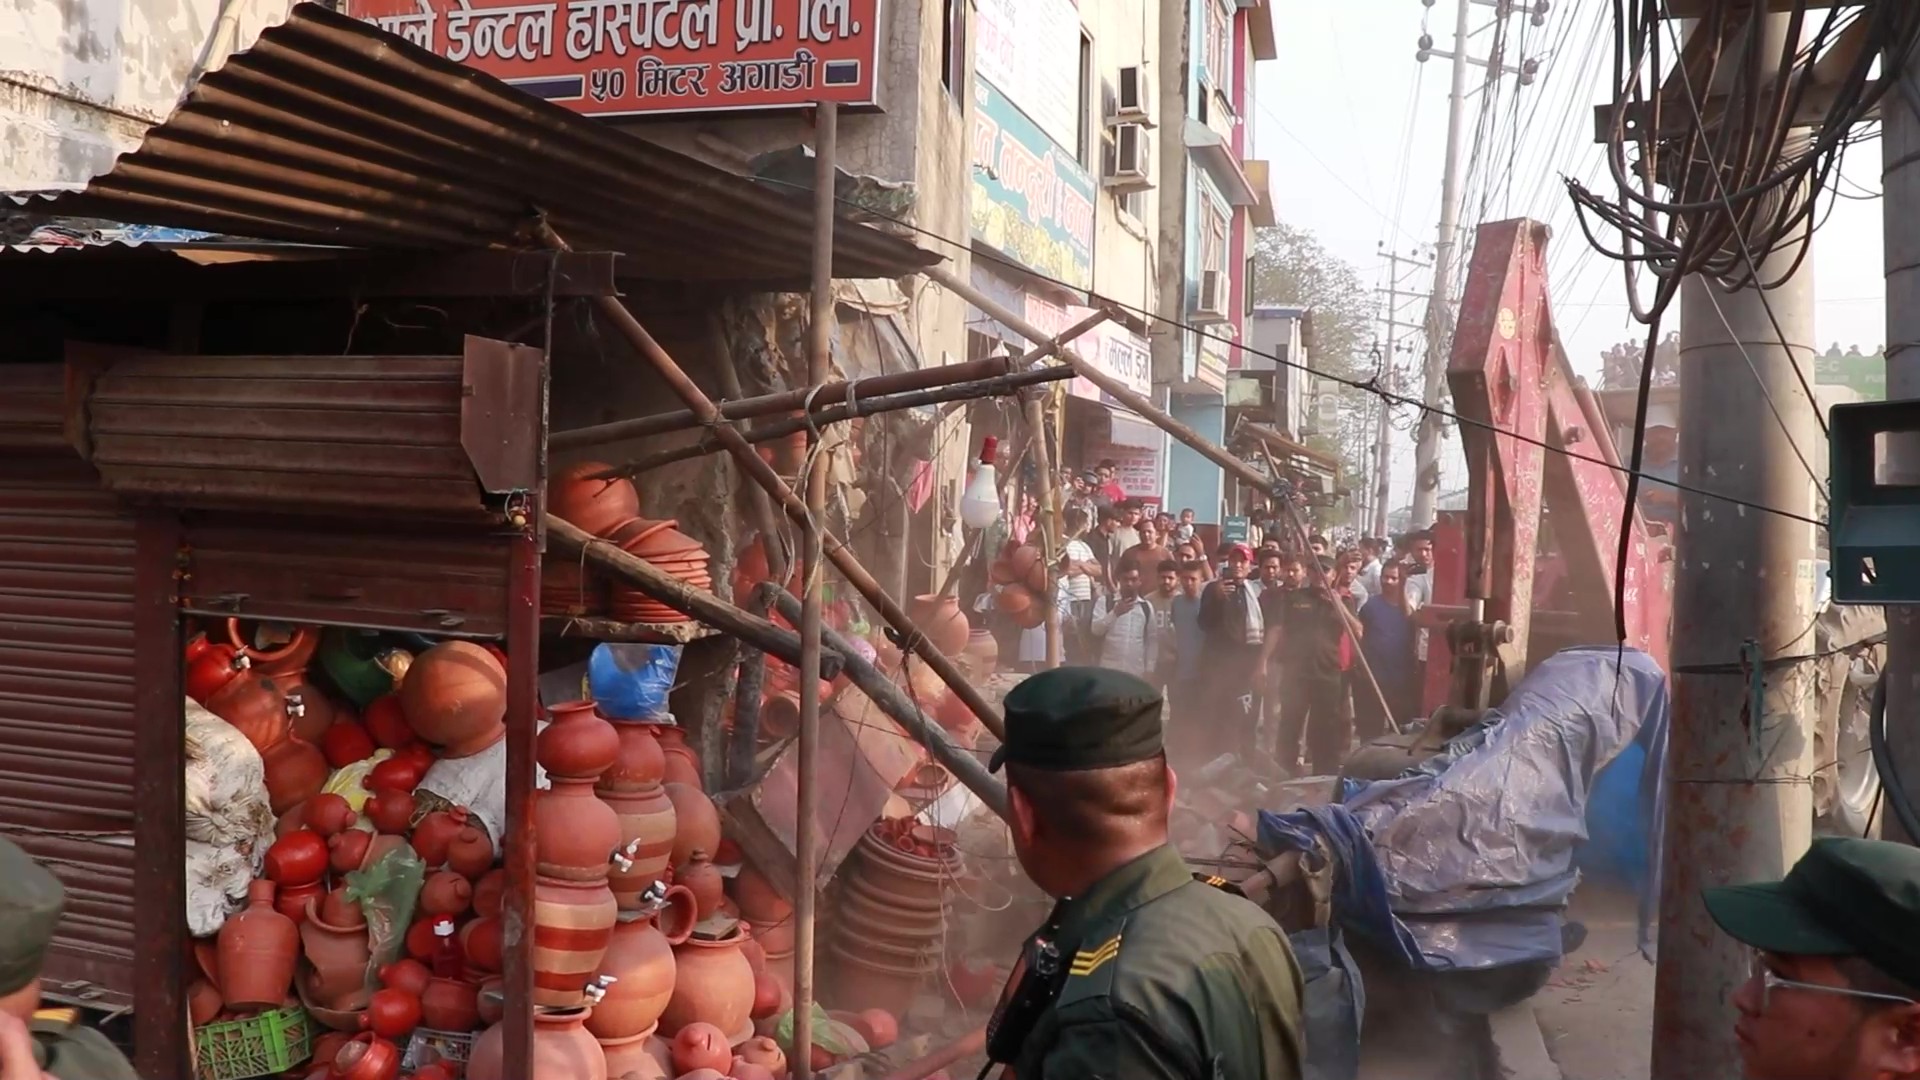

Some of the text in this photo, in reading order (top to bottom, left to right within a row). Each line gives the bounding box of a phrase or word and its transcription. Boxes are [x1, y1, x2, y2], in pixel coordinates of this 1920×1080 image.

[446, 0, 557, 62] डेन्टल
[636, 54, 711, 98] मिटर
[719, 47, 818, 94] अगाडी
